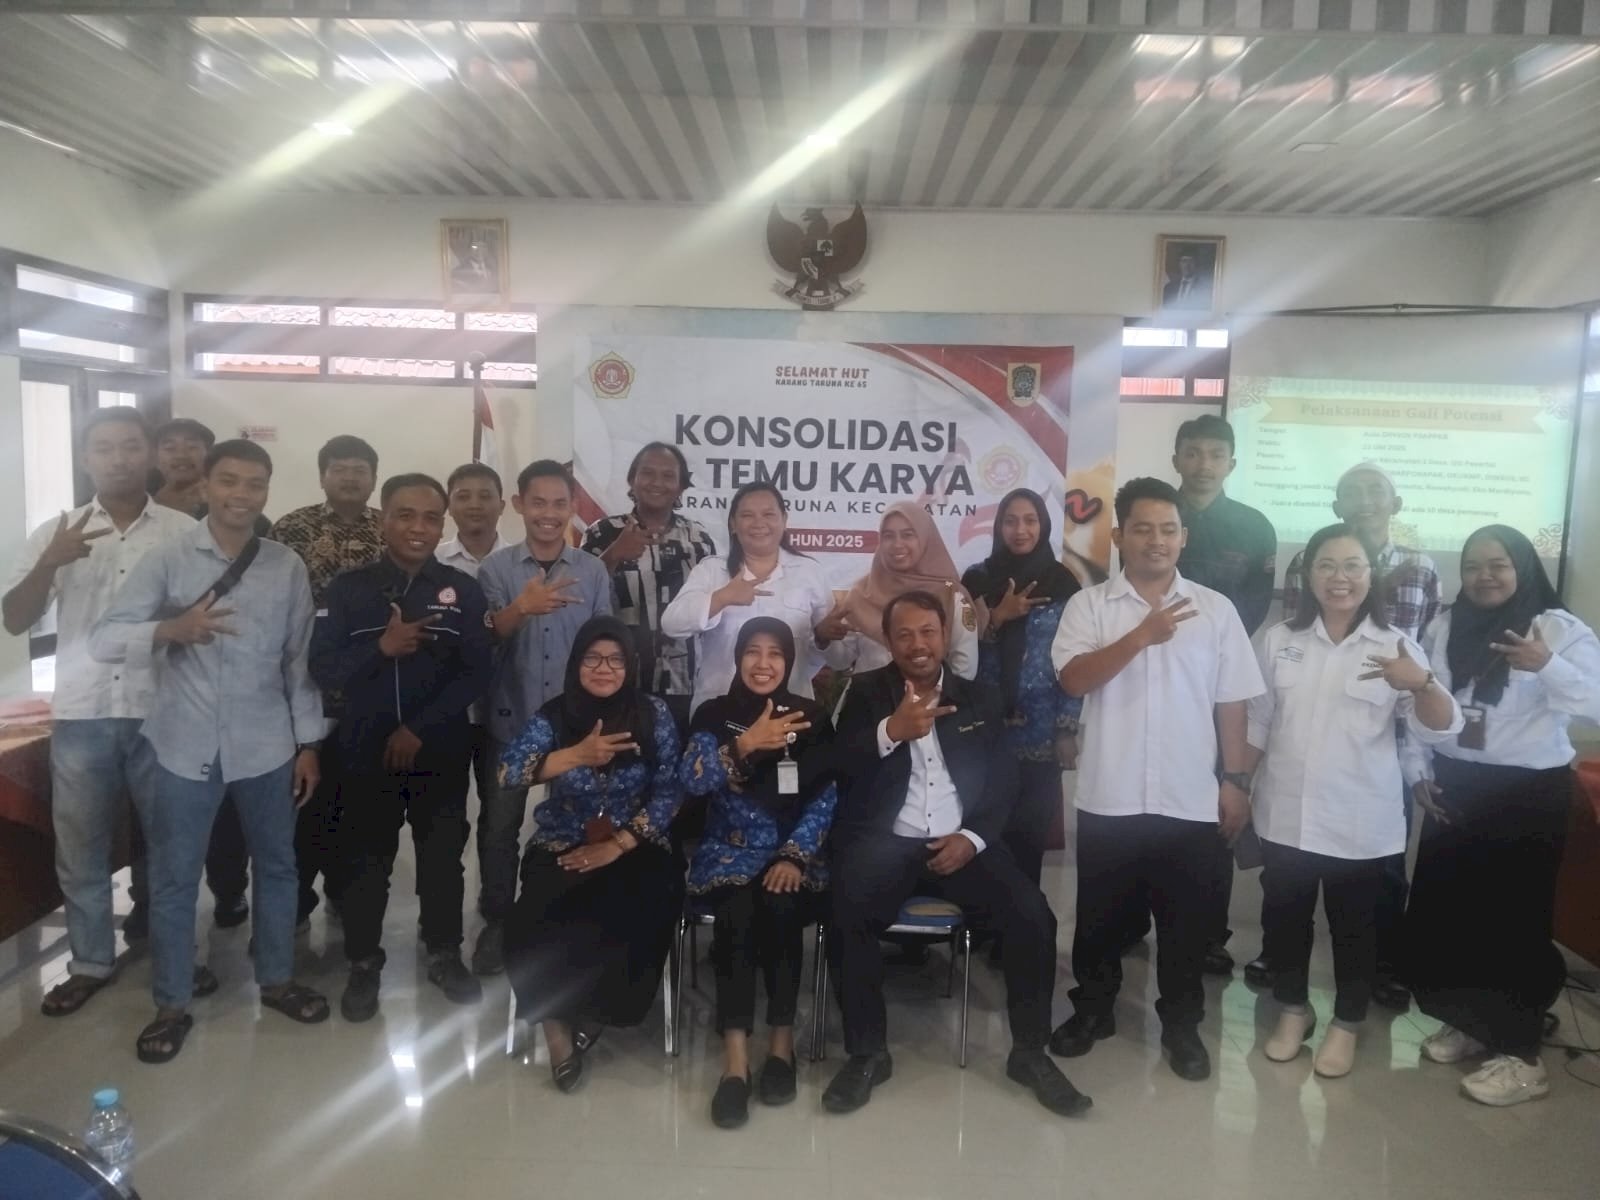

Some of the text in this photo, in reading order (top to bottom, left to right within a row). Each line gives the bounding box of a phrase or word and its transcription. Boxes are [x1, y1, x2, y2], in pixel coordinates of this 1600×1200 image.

[775, 366, 870, 379] SELAMAT HUT
[775, 378, 808, 386] KARANG
[810, 379, 842, 387] TARUNA
[675, 414, 957, 453] KONSOLIDASI
[706, 458, 818, 491] TEMU
[830, 461, 974, 496] KARYA
[784, 499, 836, 512] RUNA
[848, 501, 977, 516] KECATAN
[789, 533, 864, 547] HUN 2025
